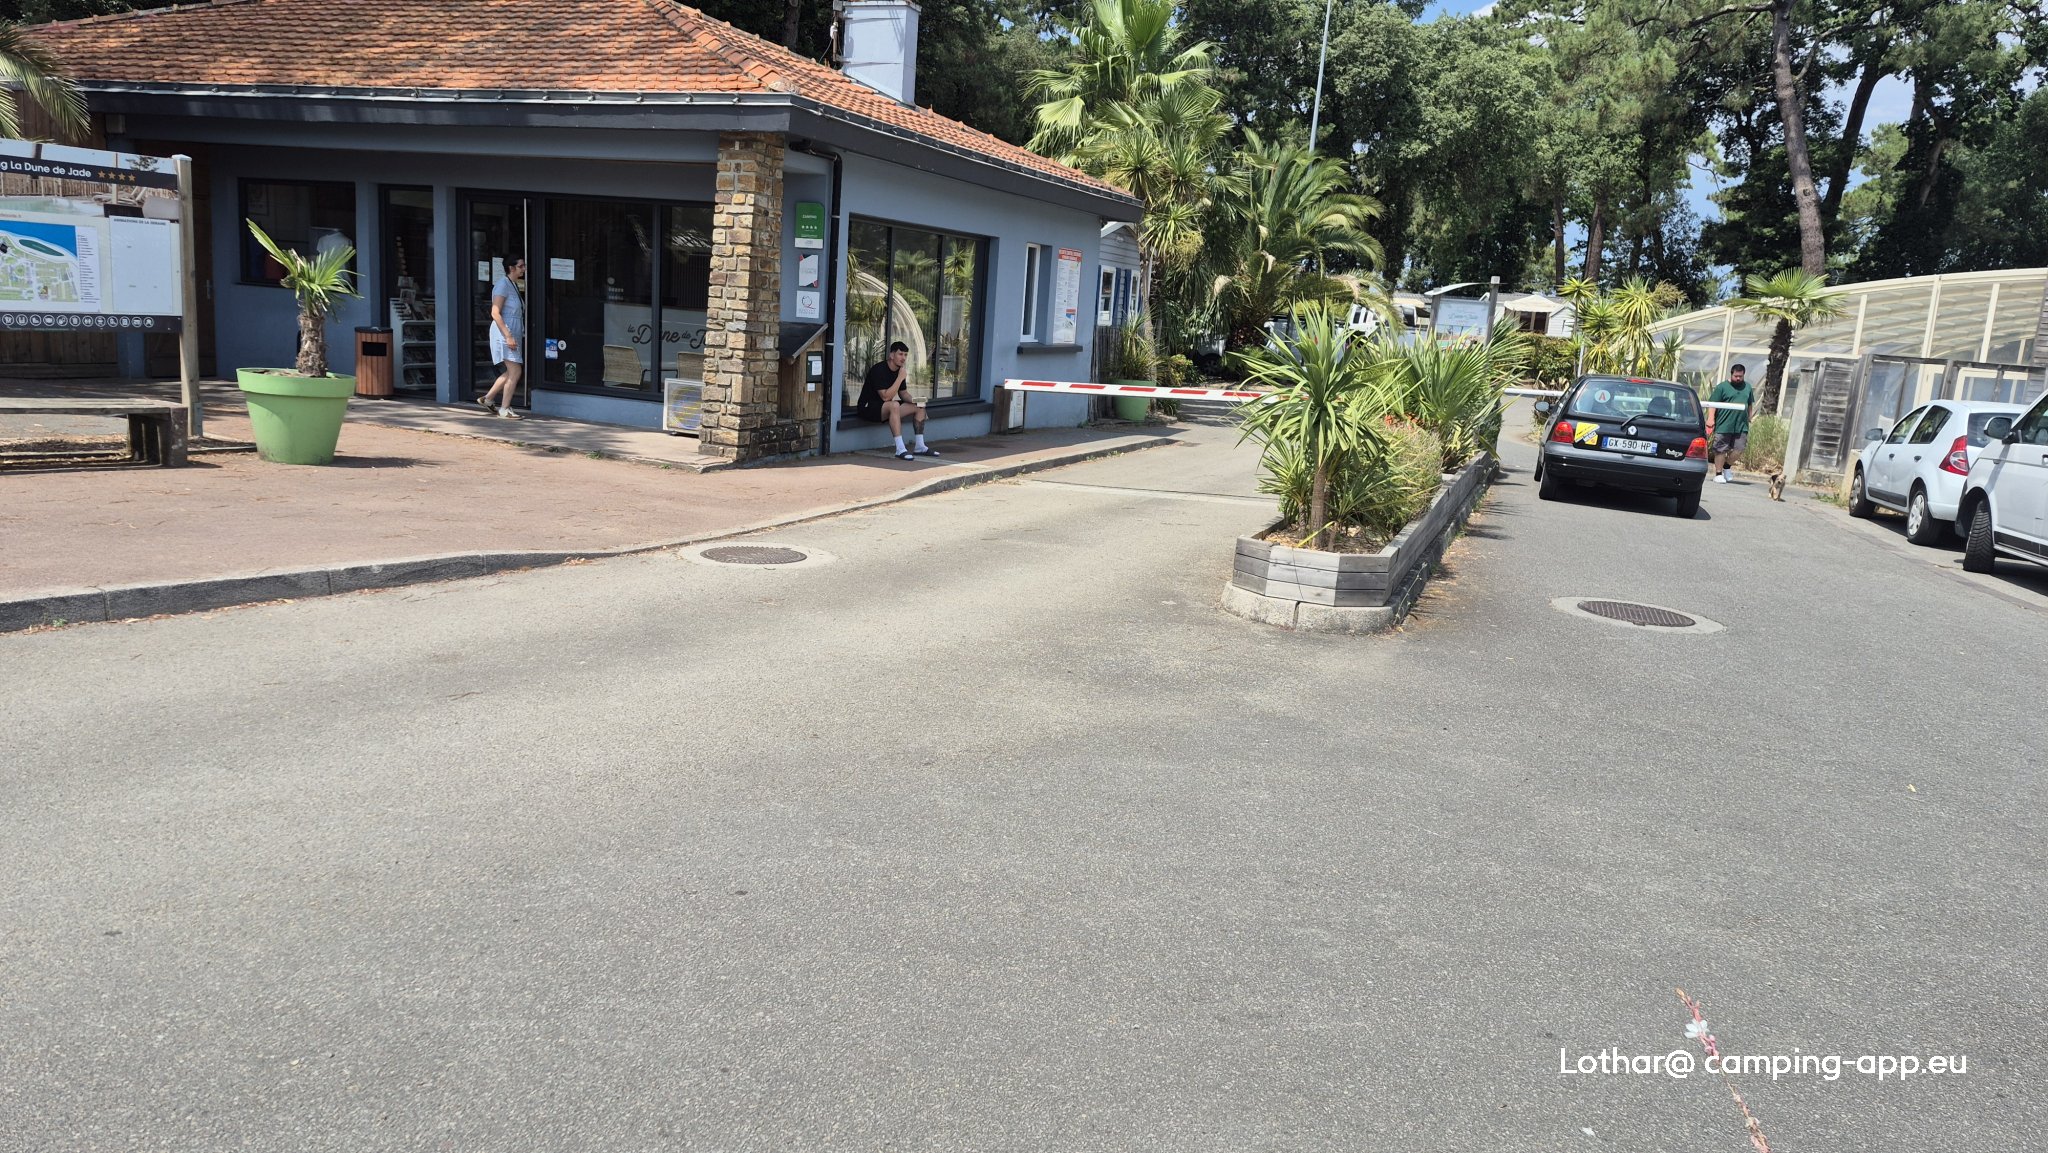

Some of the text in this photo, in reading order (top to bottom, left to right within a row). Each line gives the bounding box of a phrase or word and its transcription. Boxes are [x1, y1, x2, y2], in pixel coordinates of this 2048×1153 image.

[10, 161, 22, 170] La
[24, 162, 50, 173] Dune
[52, 166, 66, 175] de
[67, 167, 92, 178] Jade
[632, 324, 680, 345] Dne
[1599, 391, 1606, 401] A
